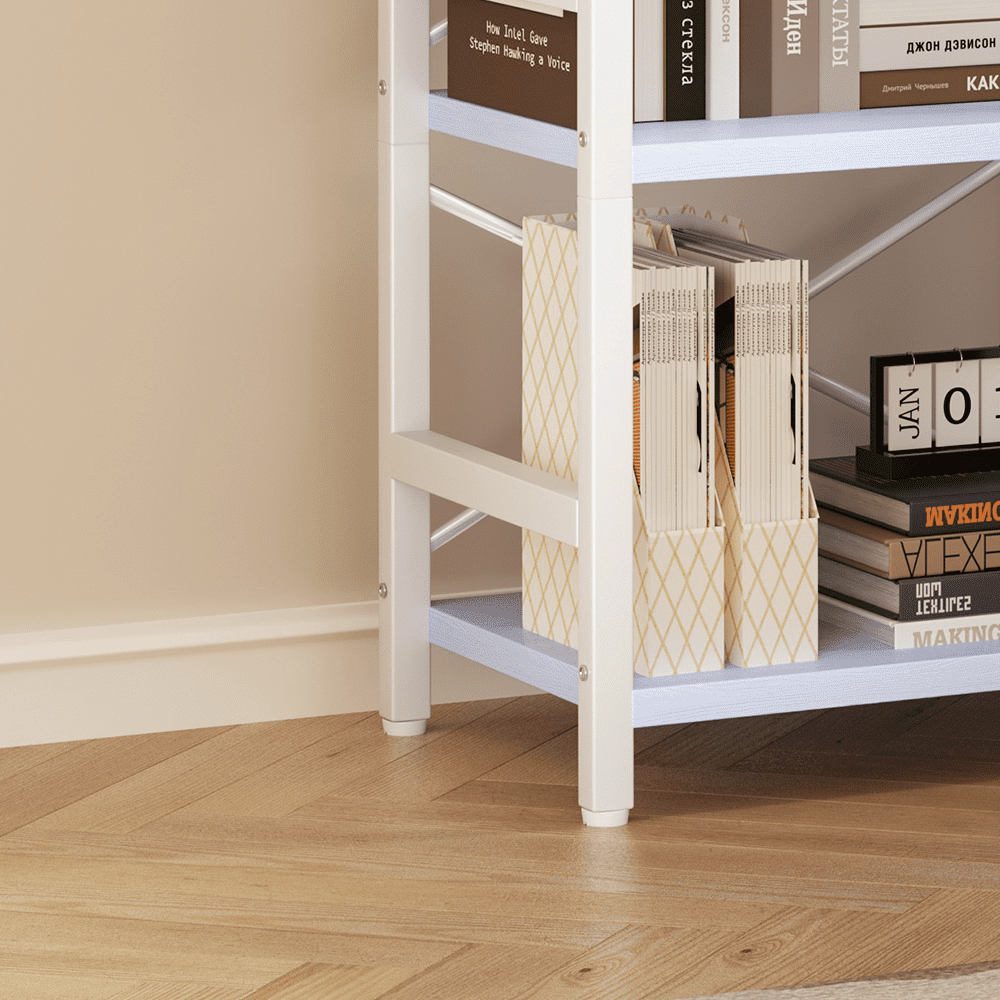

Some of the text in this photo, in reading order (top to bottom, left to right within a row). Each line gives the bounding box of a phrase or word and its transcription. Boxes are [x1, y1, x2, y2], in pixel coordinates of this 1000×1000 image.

[486, 20, 500, 35] How
[530, 30, 548, 47] Gave
[469, 36, 570, 72] Stephen Hawking a Voice
[906, 41, 940, 55] ДЖОН
[882, 81, 949, 93] Дмитрий Чернышев
[967, 75, 999, 91] КАК
[898, 387, 920, 440] JAN
